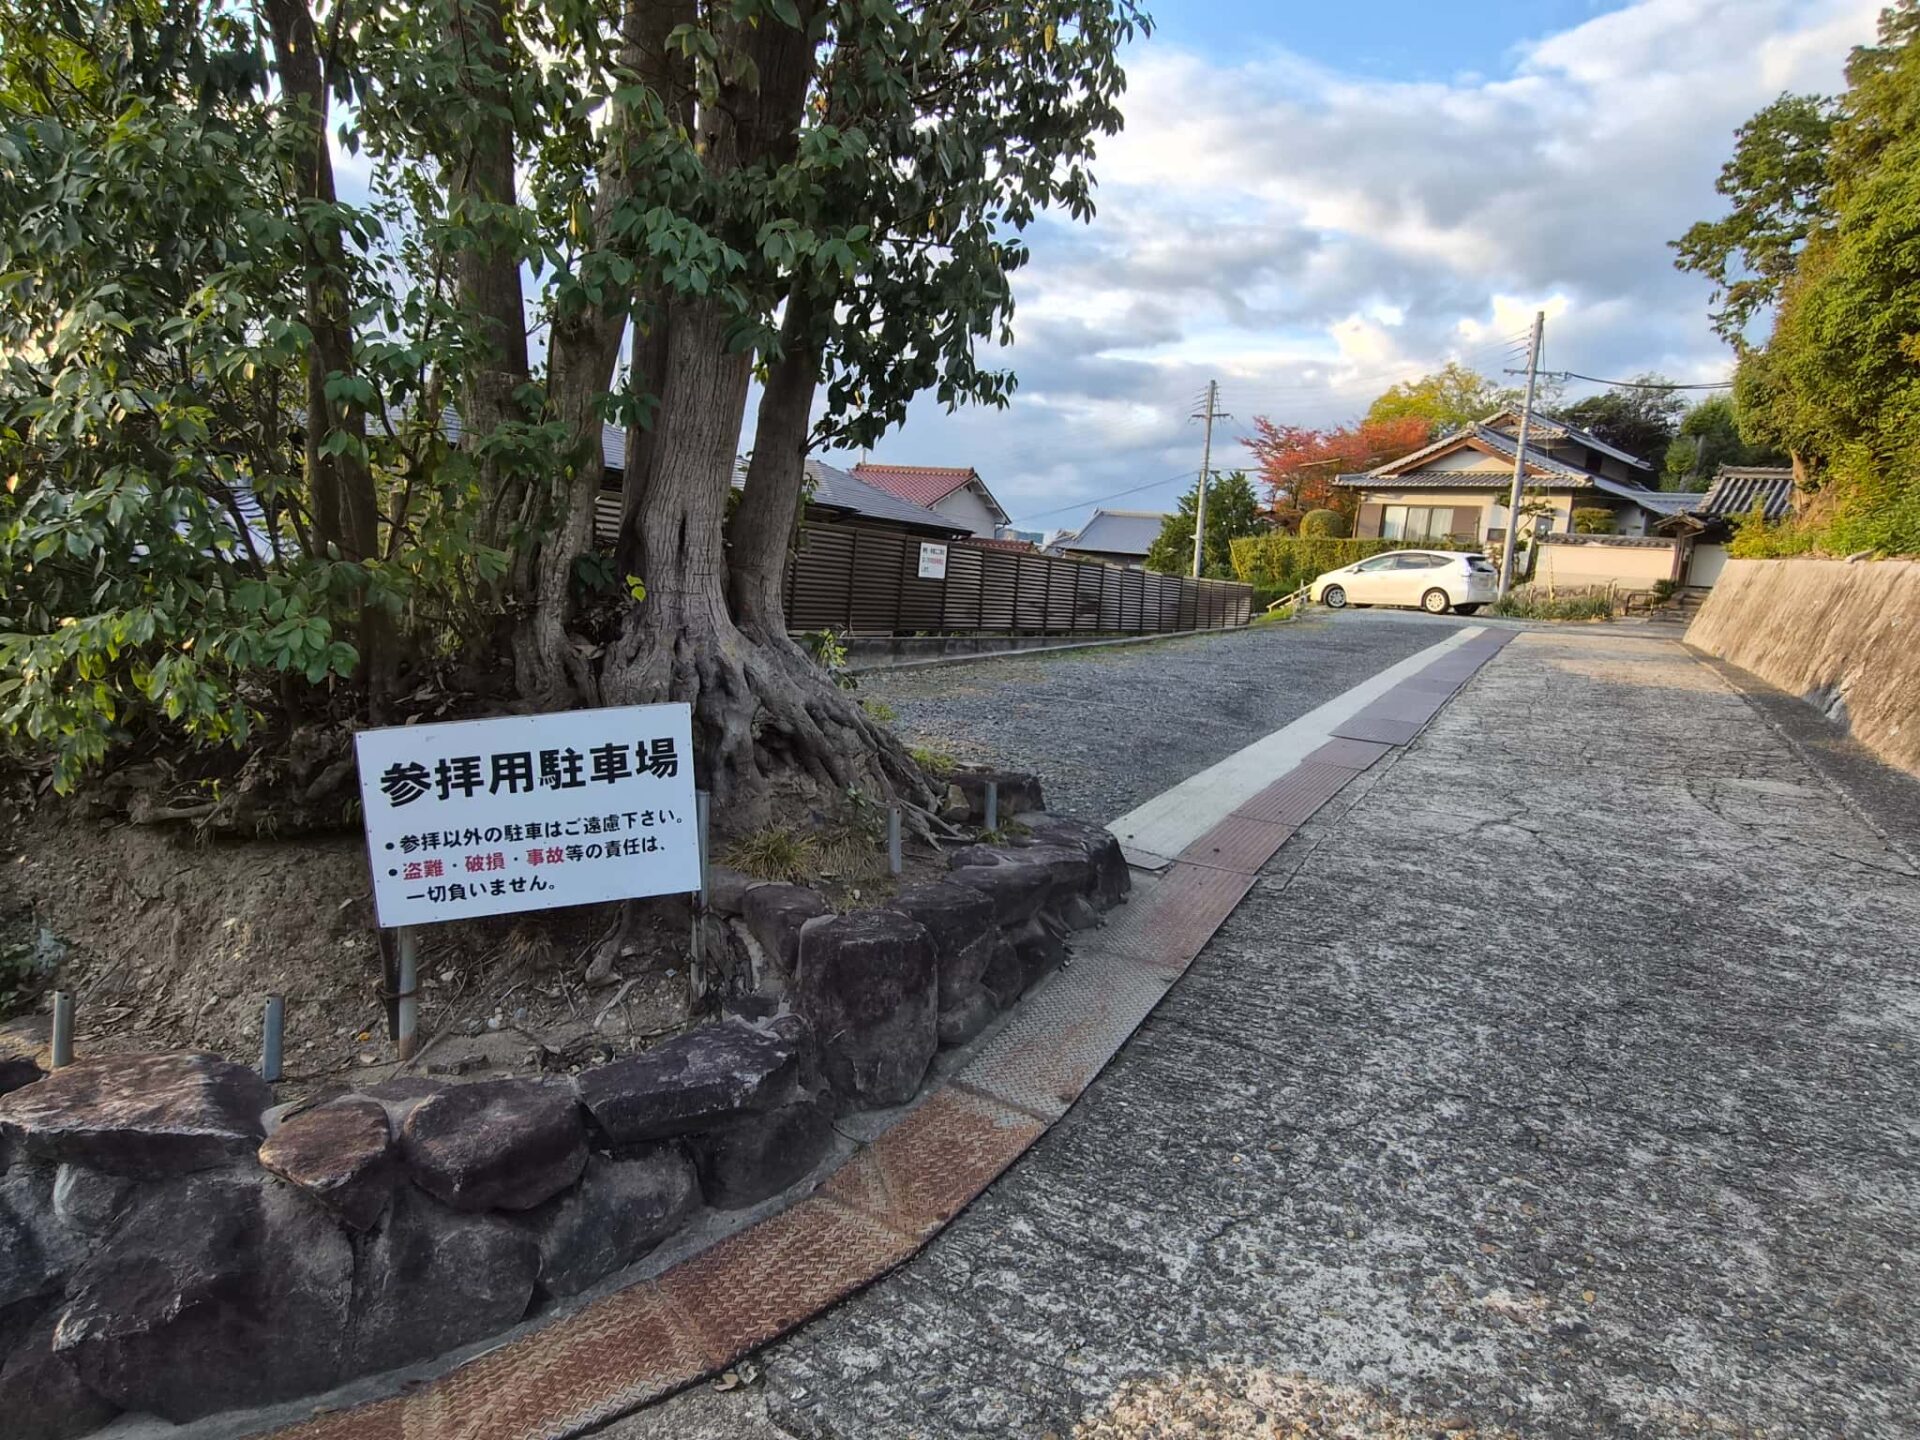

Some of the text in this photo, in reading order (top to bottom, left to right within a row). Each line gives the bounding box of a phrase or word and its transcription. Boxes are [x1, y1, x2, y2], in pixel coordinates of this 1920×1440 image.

[380, 737, 679, 808] 参拝用駐車場
[400, 808, 684, 855] 参拝以外の駐車はご遠慮下さい。
[407, 876, 556, 904] 一切負いません。
